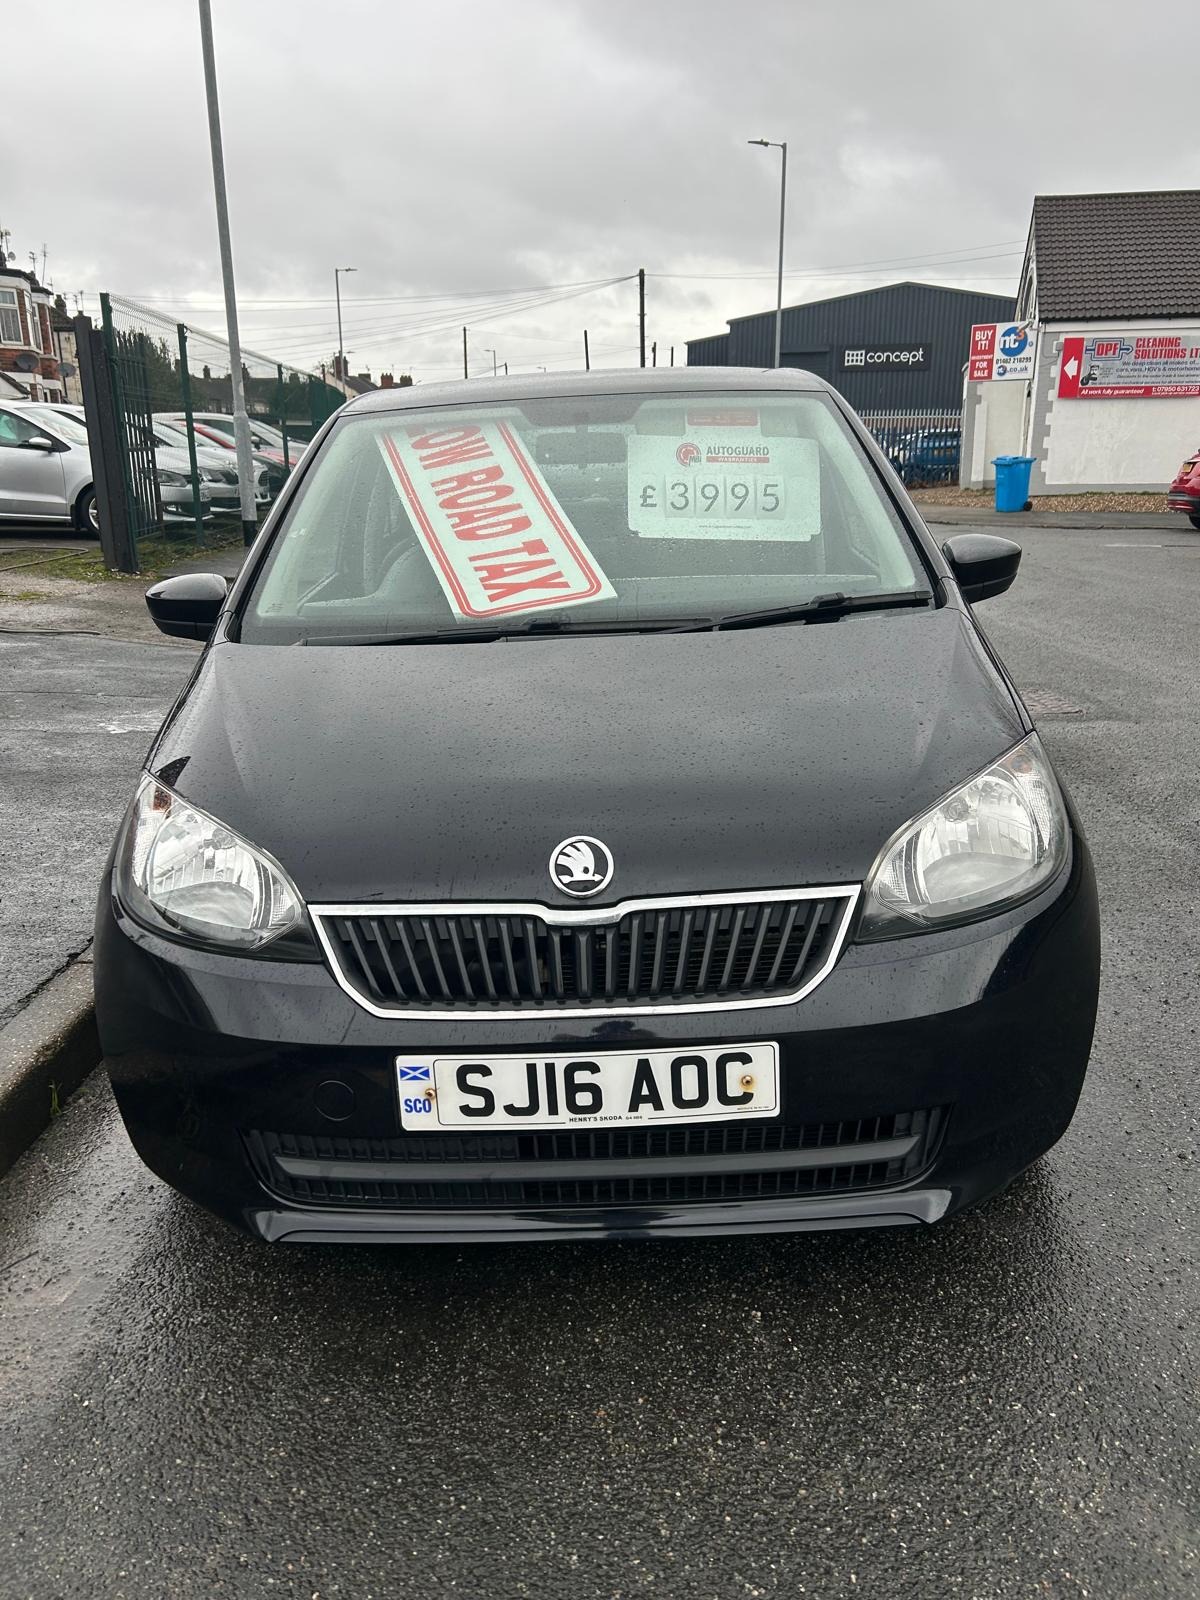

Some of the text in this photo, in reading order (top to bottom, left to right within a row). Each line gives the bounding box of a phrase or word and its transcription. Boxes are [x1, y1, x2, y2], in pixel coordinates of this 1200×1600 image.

[975, 330, 993, 341] BUY
[1136, 336, 1181, 348] CLEANING
[978, 340, 988, 350] IT!
[1096, 342, 1119, 356] DPF
[866, 348, 924, 365] concept
[1134, 348, 1200, 360] SOLUTIONS LT
[706, 444, 770, 456] AUTOGUARD
[406, 424, 572, 603] OW ROAD TAX
[455, 1052, 754, 1118] SJ16 AOC
[404, 1098, 432, 1114] SCO
